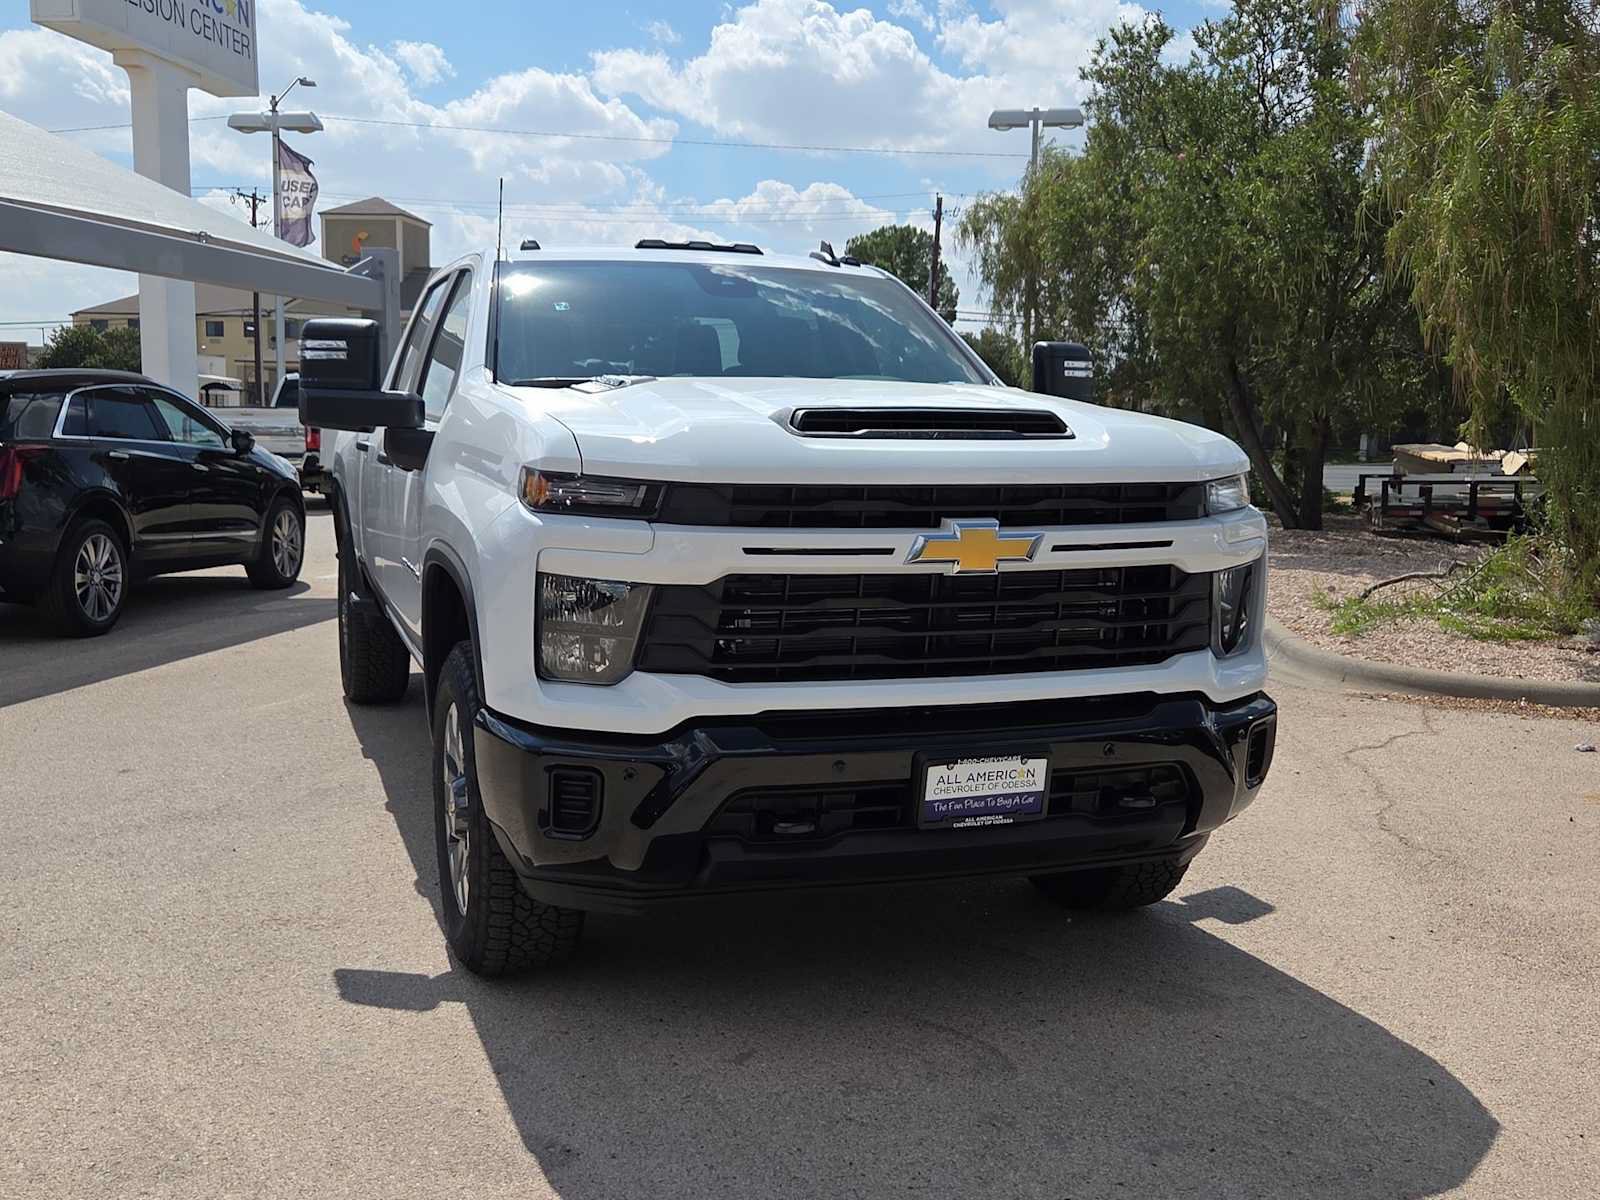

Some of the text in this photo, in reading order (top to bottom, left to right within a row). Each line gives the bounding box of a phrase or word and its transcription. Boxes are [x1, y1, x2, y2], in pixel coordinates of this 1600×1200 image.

[190, 8, 251, 59] CENTER
[936, 773, 962, 785] ALL
[933, 779, 1037, 796] CHEVROLET OF ODESSA
[933, 801, 948, 812] The
[986, 797, 996, 807] To
[1012, 796, 1020, 805] A
